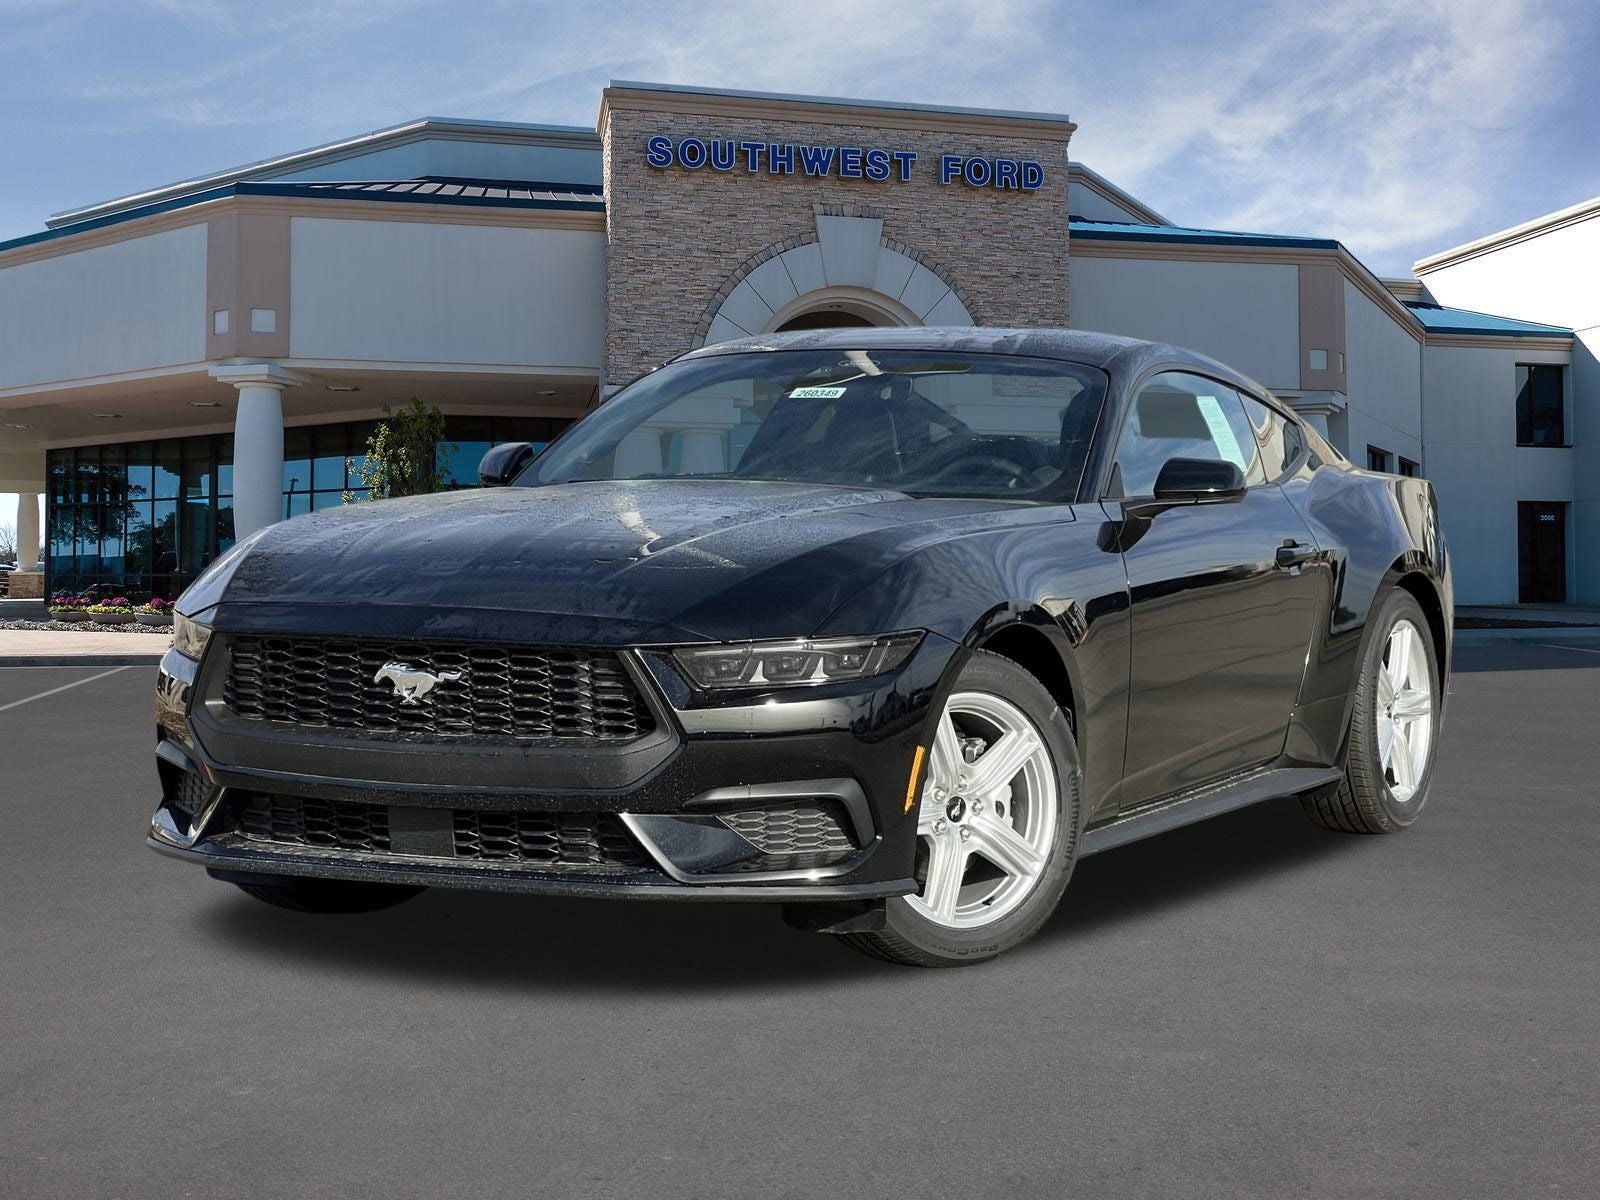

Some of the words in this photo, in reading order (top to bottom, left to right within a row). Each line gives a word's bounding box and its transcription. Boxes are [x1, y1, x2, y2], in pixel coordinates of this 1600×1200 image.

[646, 135, 918, 182] SOUTHWEST
[940, 155, 1045, 191] FORD
[796, 389, 839, 397] 260349
